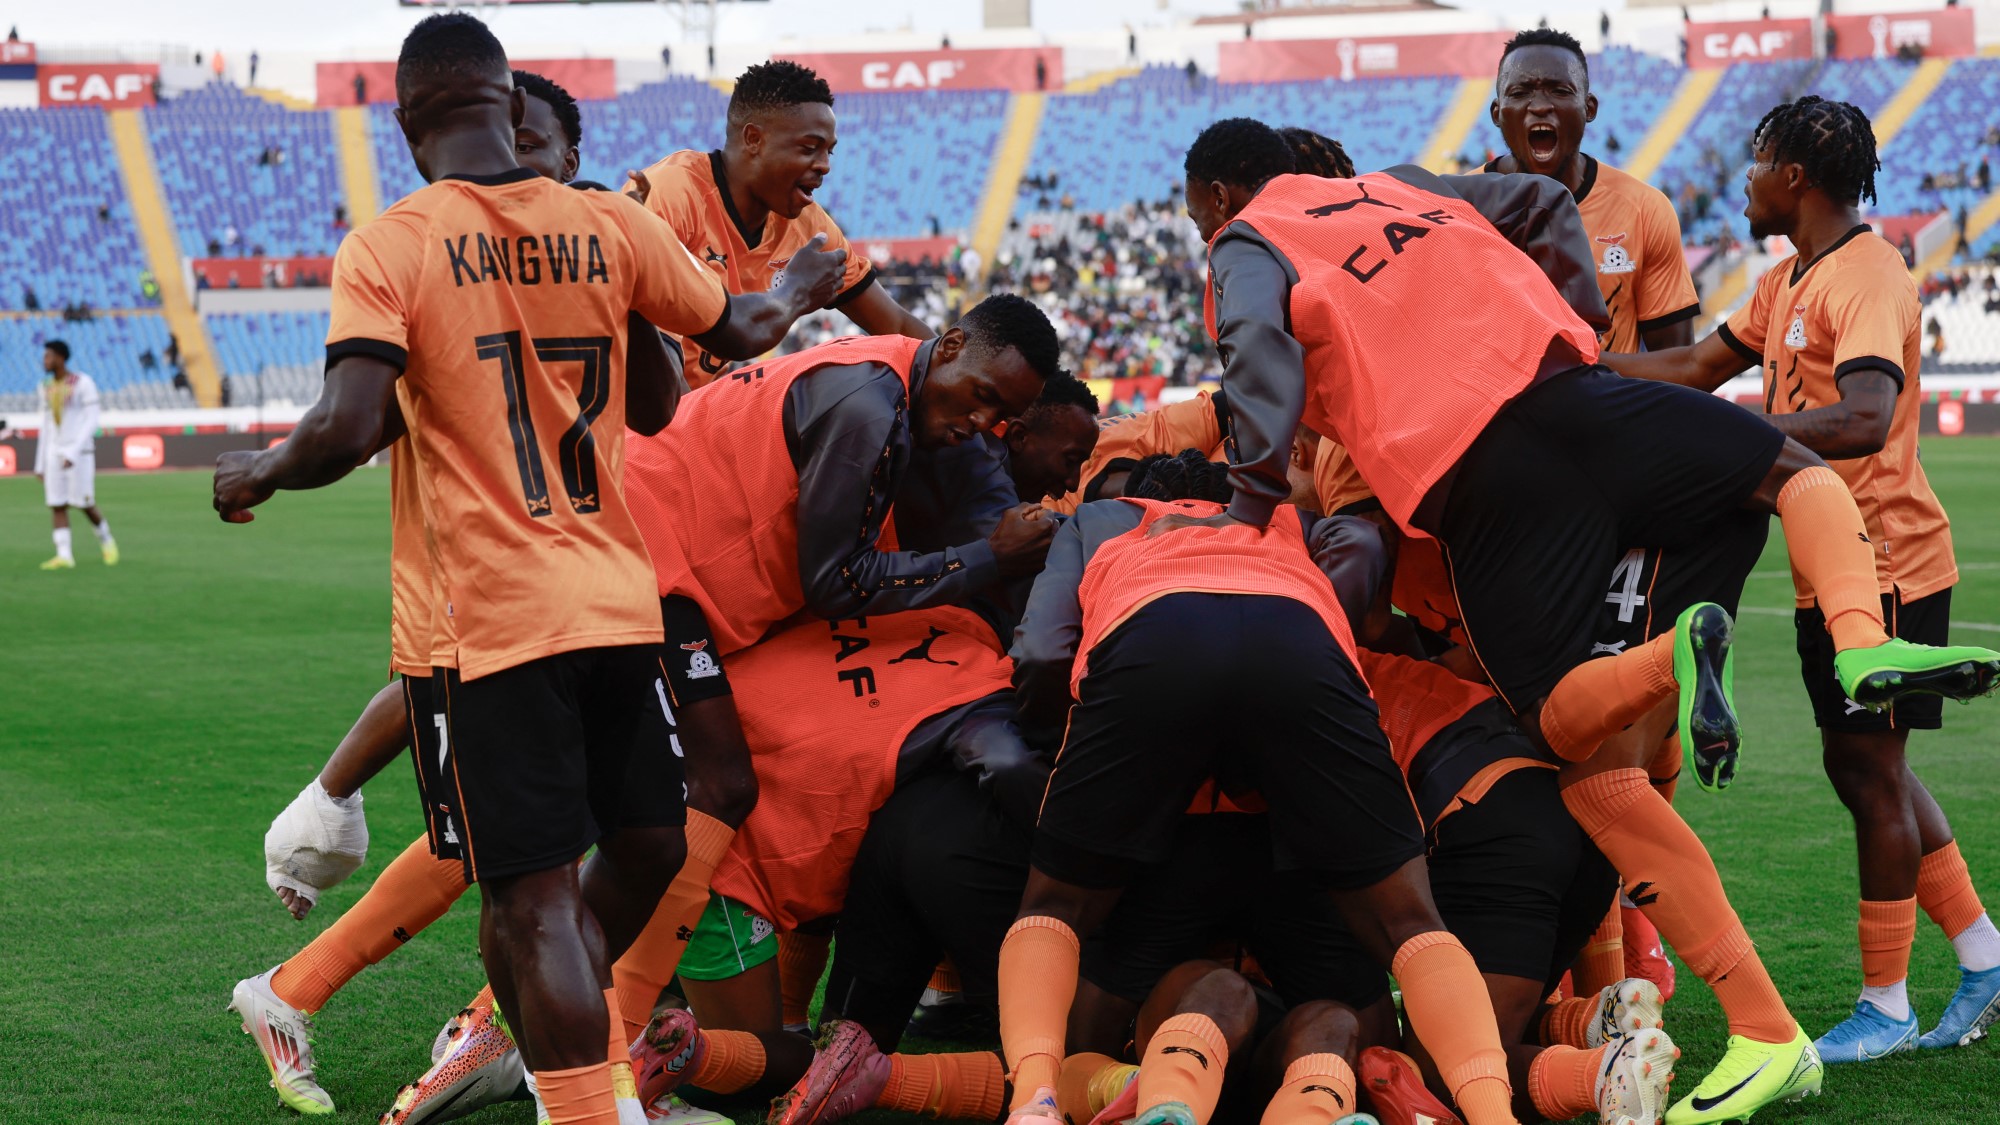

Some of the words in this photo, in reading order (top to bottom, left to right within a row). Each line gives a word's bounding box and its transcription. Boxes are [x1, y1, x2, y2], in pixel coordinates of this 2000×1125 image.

[1703, 32, 1786, 58] CAF
[49, 74, 144, 100] CAF
[862, 61, 956, 88] CAF
[444, 232, 609, 287] KANGWA
[1341, 209, 1454, 284] CAF
[475, 330, 613, 517] 17
[1605, 548, 1646, 623] 4
